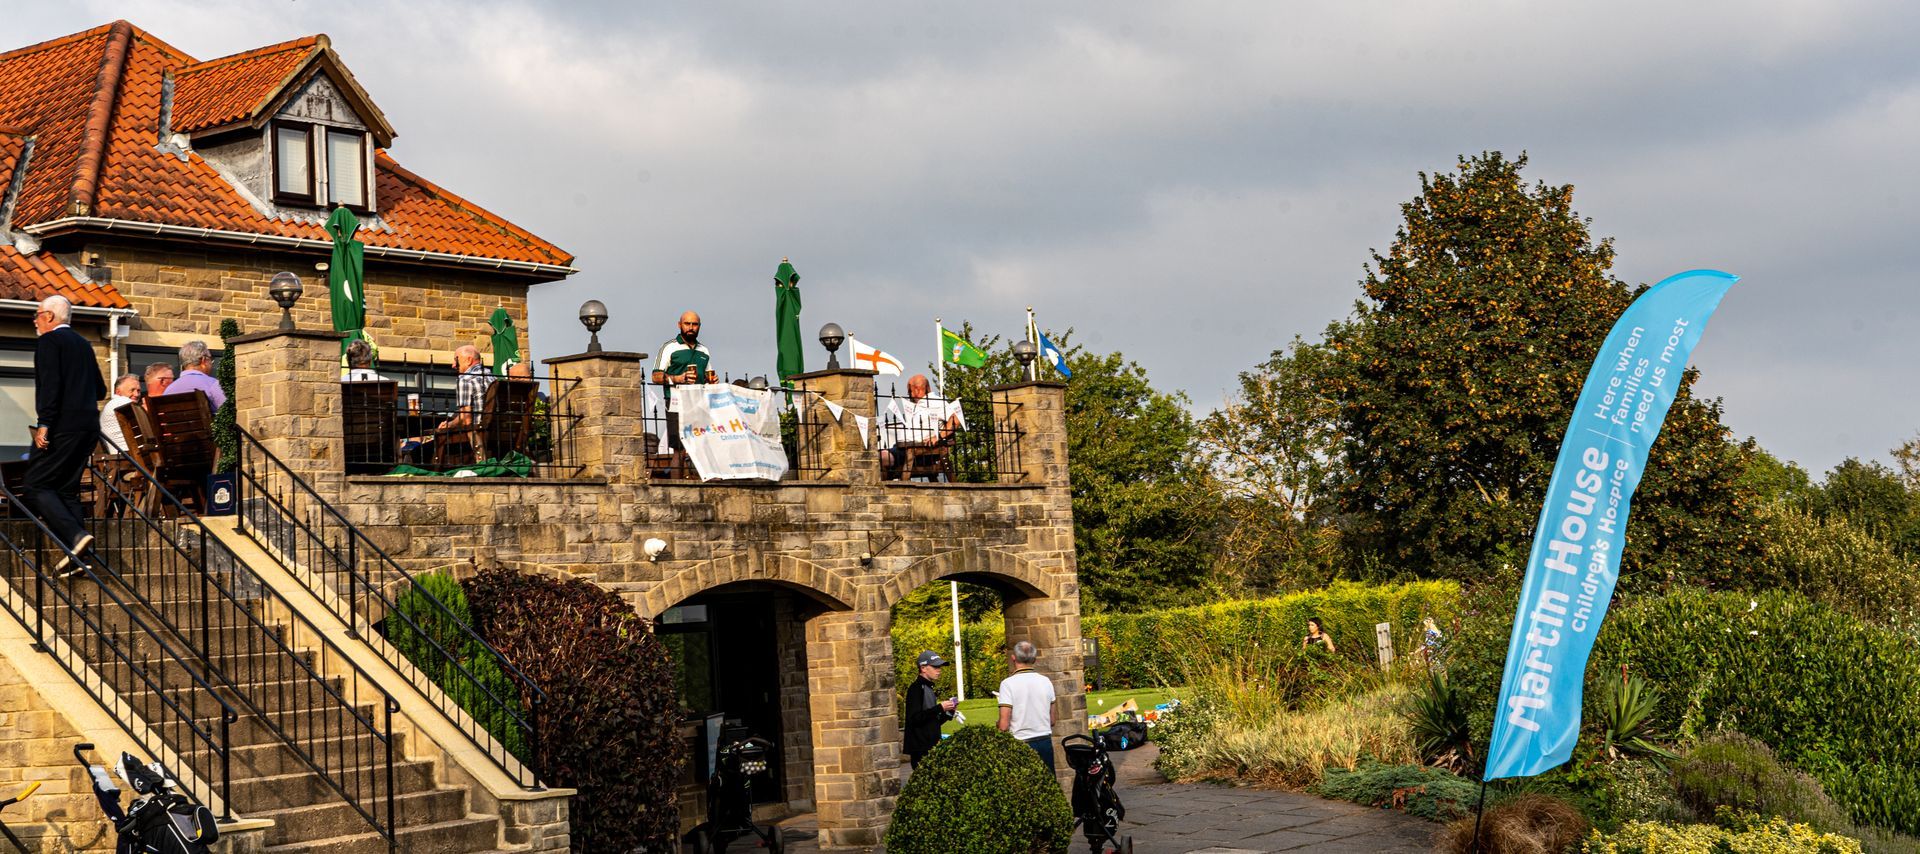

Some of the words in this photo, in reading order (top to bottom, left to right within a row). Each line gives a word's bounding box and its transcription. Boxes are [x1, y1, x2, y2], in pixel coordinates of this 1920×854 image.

[1594, 376, 1622, 420] Here
[1616, 326, 1645, 372] when
[1611, 357, 1649, 426] families
[1630, 389, 1656, 433] need
[1650, 366, 1667, 389] us
[1659, 316, 1690, 364] most
[1508, 590, 1570, 732] Martin
[1544, 446, 1609, 576] House
[1571, 538, 1610, 633] Children's
[1599, 458, 1630, 535] Hospice
